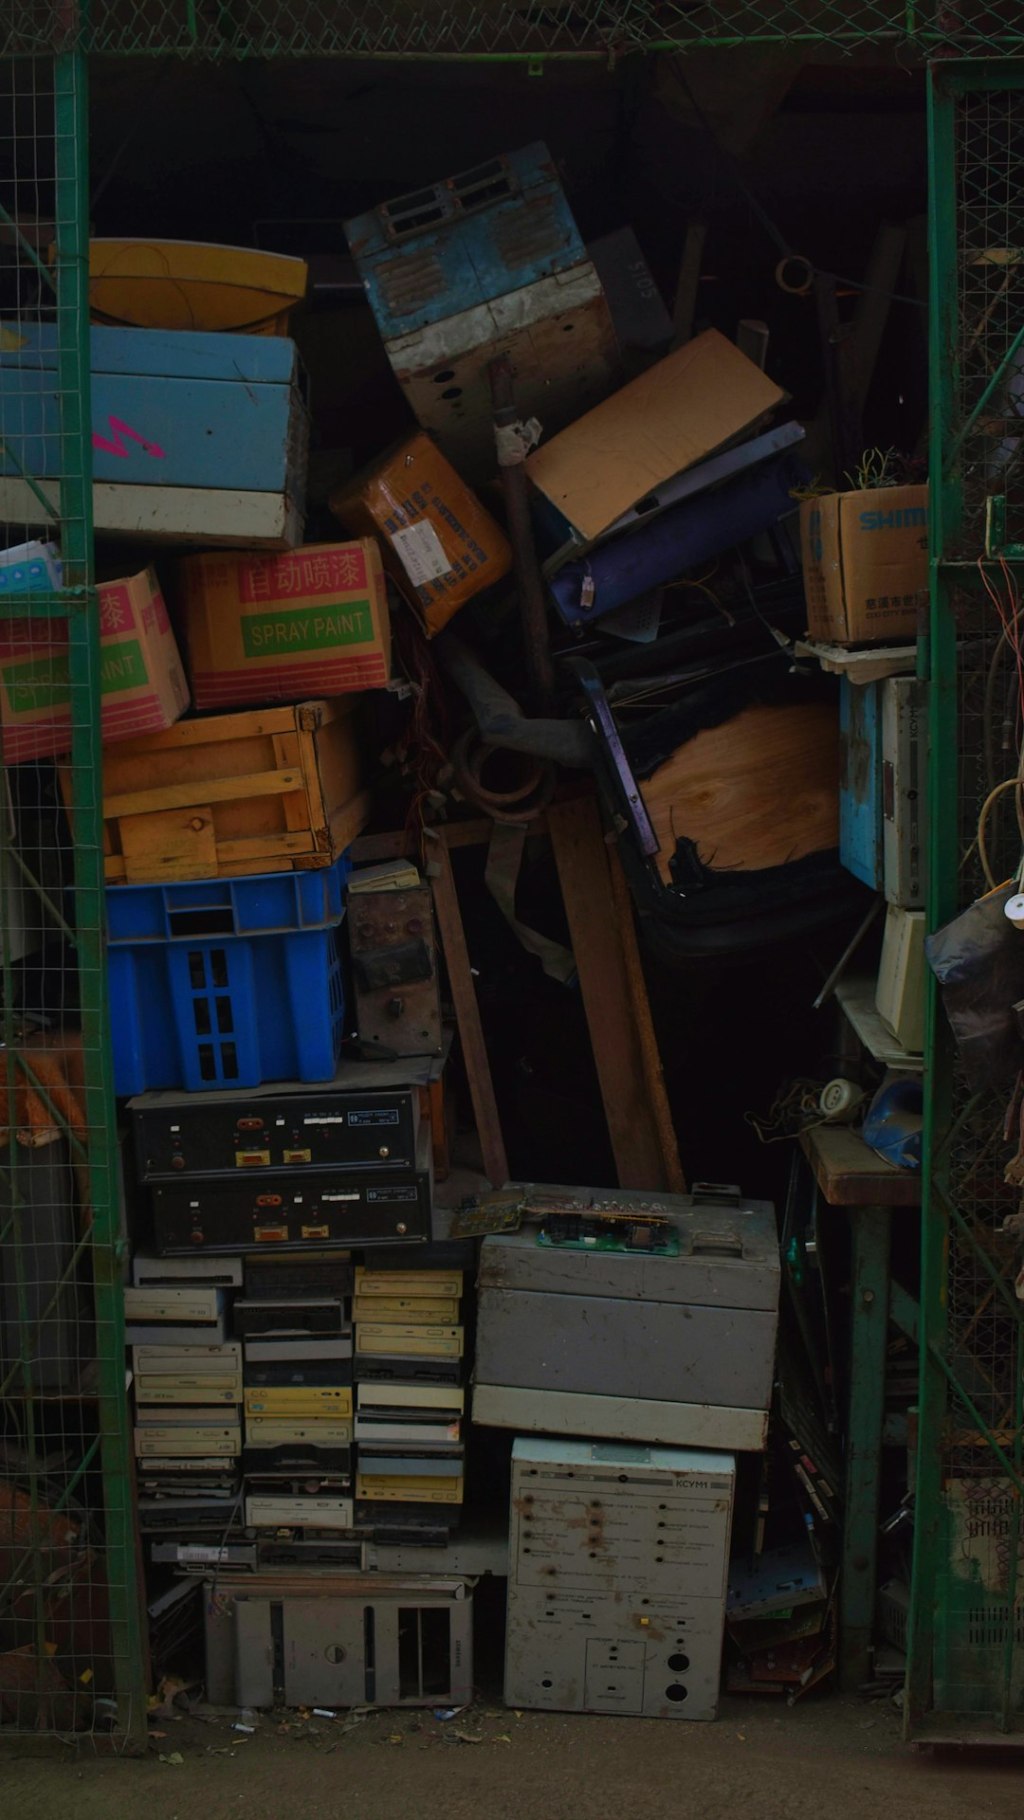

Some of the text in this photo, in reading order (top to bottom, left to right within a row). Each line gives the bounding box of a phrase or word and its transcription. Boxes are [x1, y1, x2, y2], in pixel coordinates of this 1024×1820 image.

[248, 552, 360, 598] 自动喷漆
[250, 611, 364, 647] SPRAY PAINT
